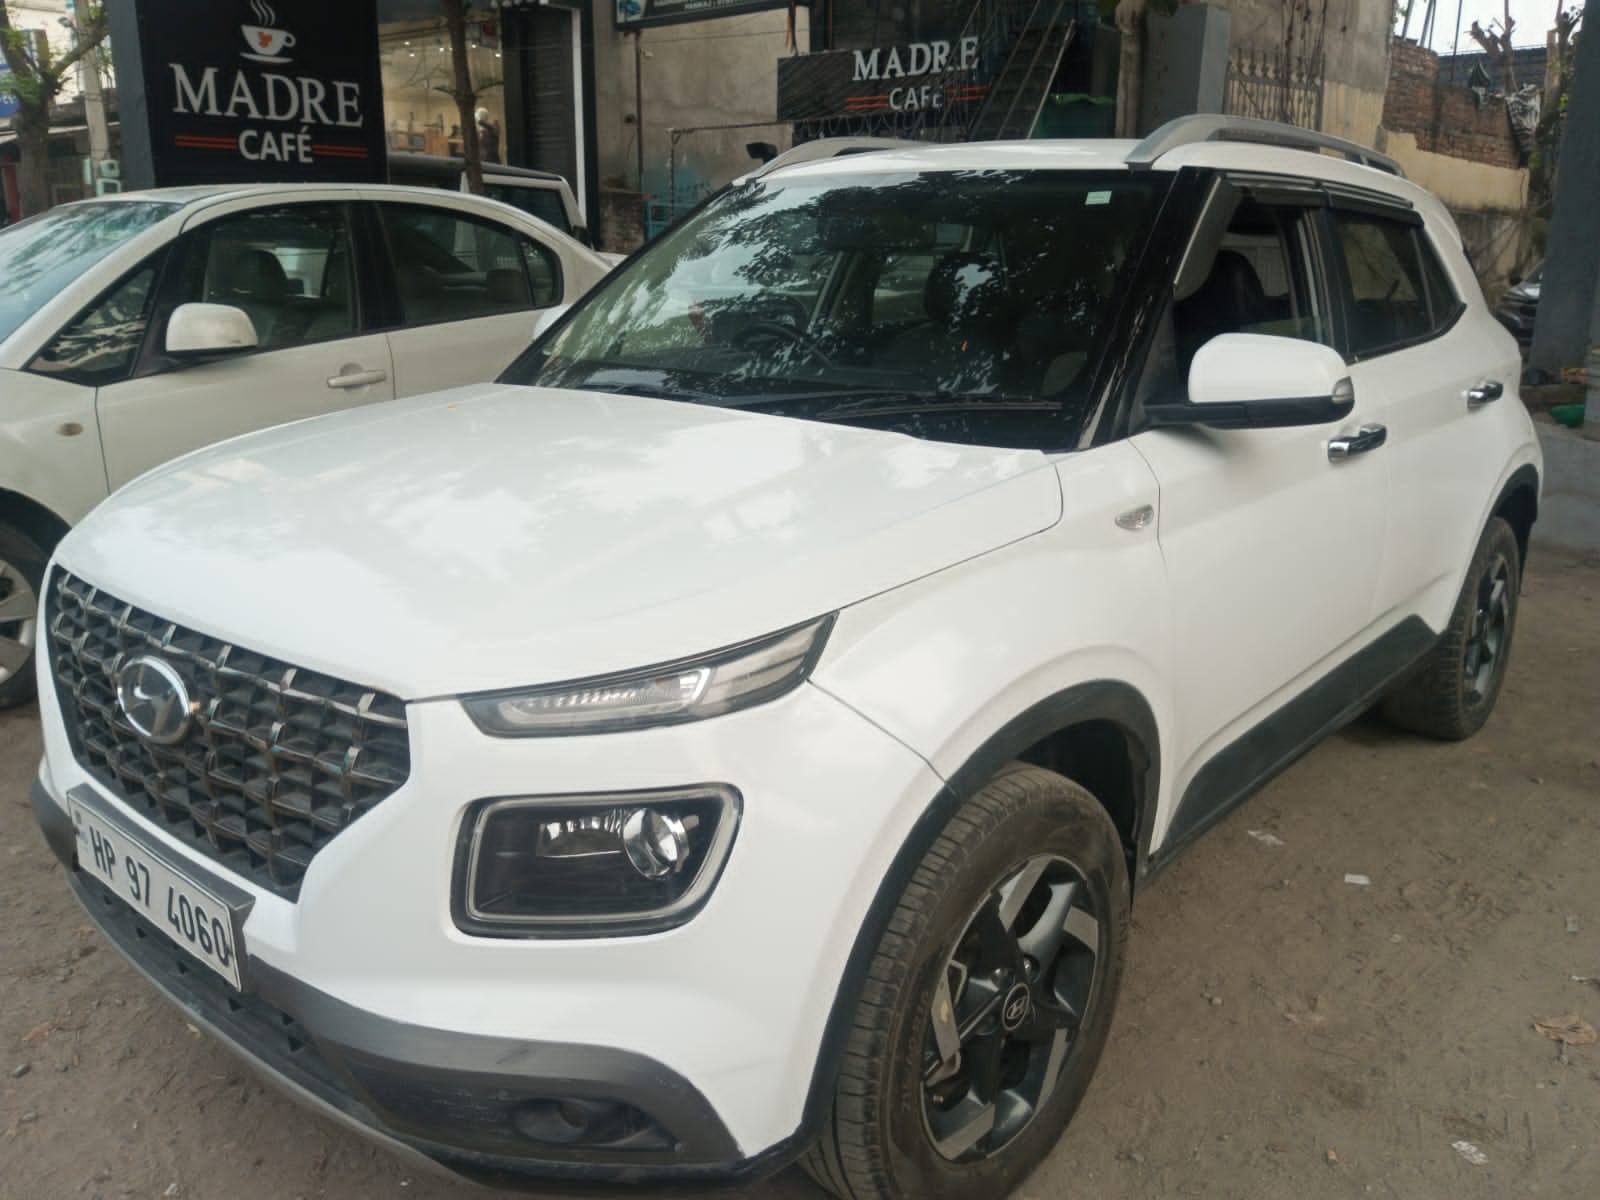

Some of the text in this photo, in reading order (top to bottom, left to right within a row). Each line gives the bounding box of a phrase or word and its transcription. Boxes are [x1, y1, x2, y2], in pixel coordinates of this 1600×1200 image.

[852, 36, 979, 81] MADRE
[168, 63, 364, 129] MADRE
[238, 125, 314, 164] CAFÉ
[89, 826, 233, 968] HP 97 4060
